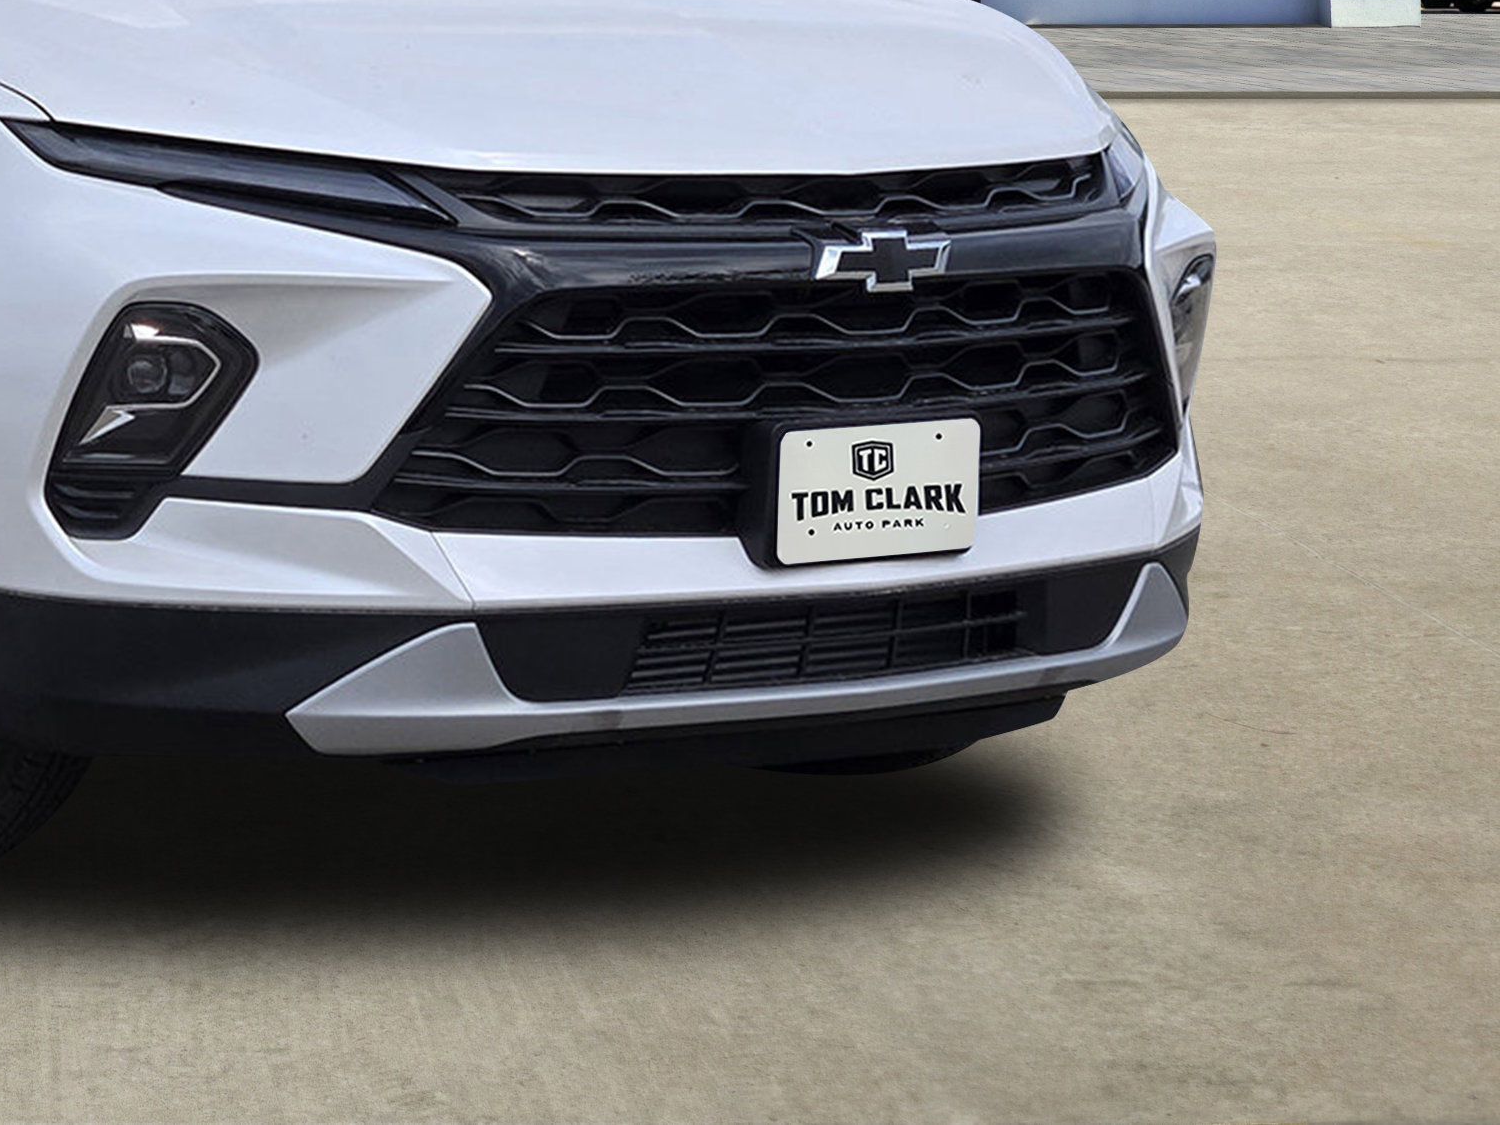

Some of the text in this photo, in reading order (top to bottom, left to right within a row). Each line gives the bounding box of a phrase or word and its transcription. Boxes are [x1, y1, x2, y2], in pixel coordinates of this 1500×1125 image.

[858, 448, 888, 472] TC
[791, 483, 966, 521] TOM CLARK
[833, 517, 925, 531] AUTO PARK
